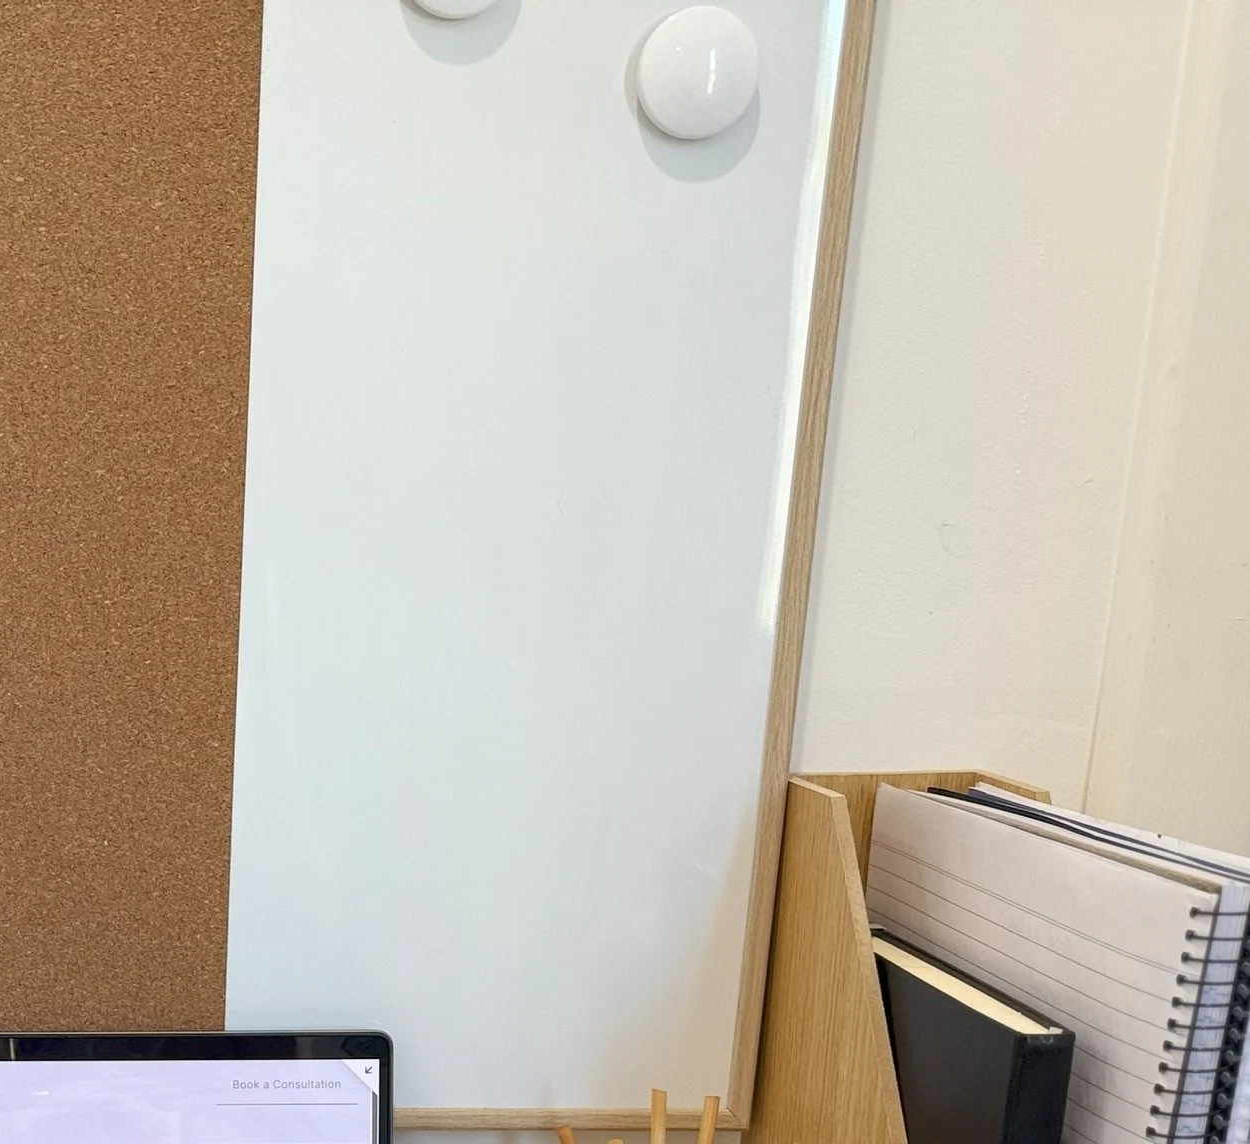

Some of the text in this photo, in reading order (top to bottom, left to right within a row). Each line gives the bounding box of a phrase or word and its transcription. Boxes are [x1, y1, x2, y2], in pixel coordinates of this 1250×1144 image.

[232, 1079, 342, 1090] Book a Consultation
